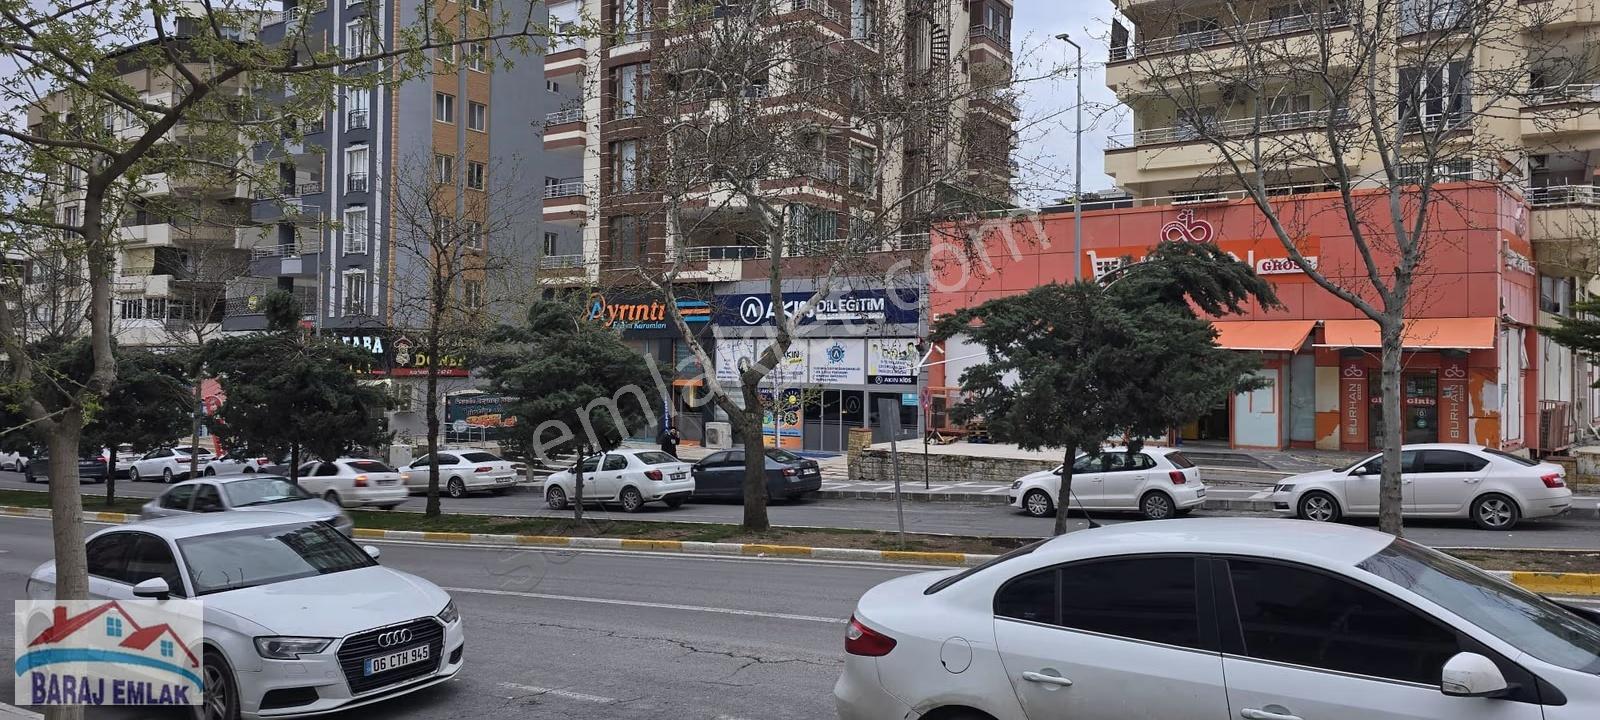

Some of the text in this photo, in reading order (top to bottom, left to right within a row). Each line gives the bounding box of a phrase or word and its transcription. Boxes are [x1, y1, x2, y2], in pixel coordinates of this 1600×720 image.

[1450, 384, 1459, 439] BURHAN
[373, 646, 428, 672] 06 CTH 945
